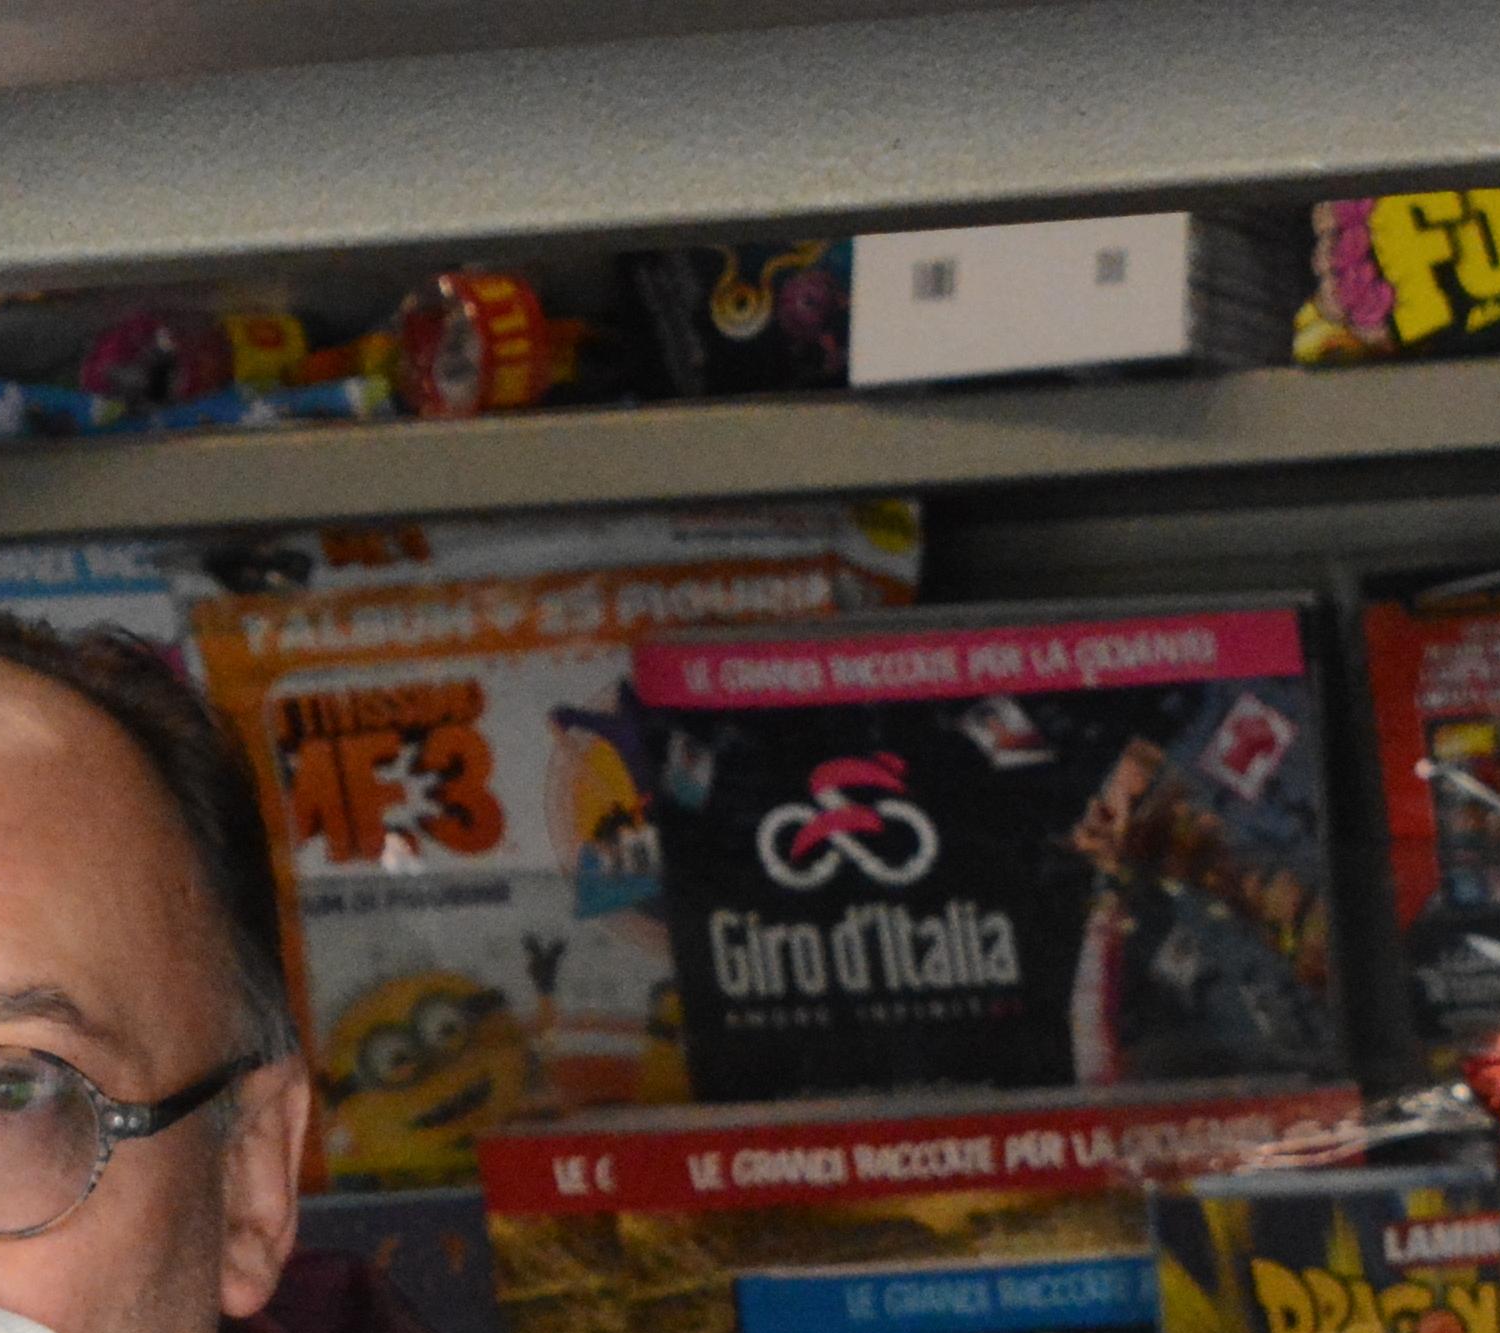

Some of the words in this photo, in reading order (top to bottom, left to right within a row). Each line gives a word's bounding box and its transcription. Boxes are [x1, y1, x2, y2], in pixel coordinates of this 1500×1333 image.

[679, 655, 716, 695] LE
[719, 648, 825, 694] GRANDI
[966, 636, 1030, 681] PER
[1036, 634, 1074, 677] LA
[707, 909, 828, 997] Giro
[836, 900, 1022, 994] d'Italia
